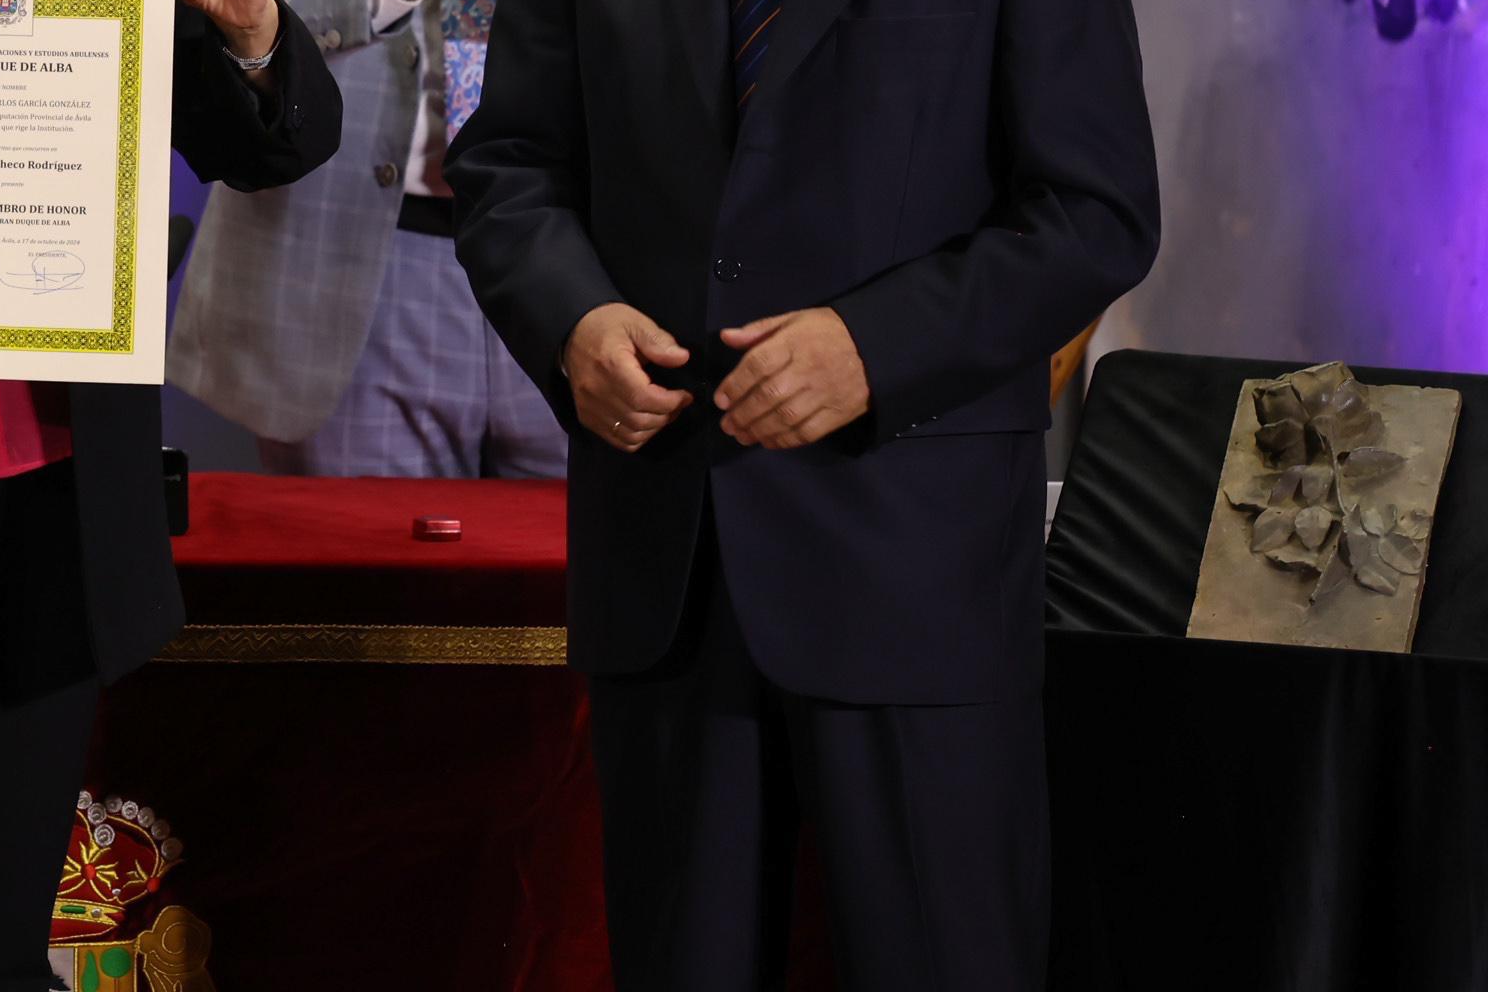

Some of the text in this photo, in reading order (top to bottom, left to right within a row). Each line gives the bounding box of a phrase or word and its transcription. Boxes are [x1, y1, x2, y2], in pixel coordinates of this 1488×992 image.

[34, 50, 69, 58] ESTUDIOS
[69, 51, 110, 59] ABULENSES
[20, 61, 38, 71] DE
[39, 62, 74, 72] ALBA
[18, 97, 48, 108] GARCÍA
[49, 99, 92, 108] GONZÁLEZ
[30, 113, 64, 121] Provincial
[65, 114, 73, 122] de
[74, 113, 92, 121] Ávila
[14, 124, 29, 132] rige
[29, 124, 36, 132] la
[27, 160, 83, 172] Rodríguez
[29, 204, 45, 214] DE
[46, 205, 88, 215] HONOR
[15, 218, 41, 226] DUQUE
[52, 219, 71, 227] ALBA
